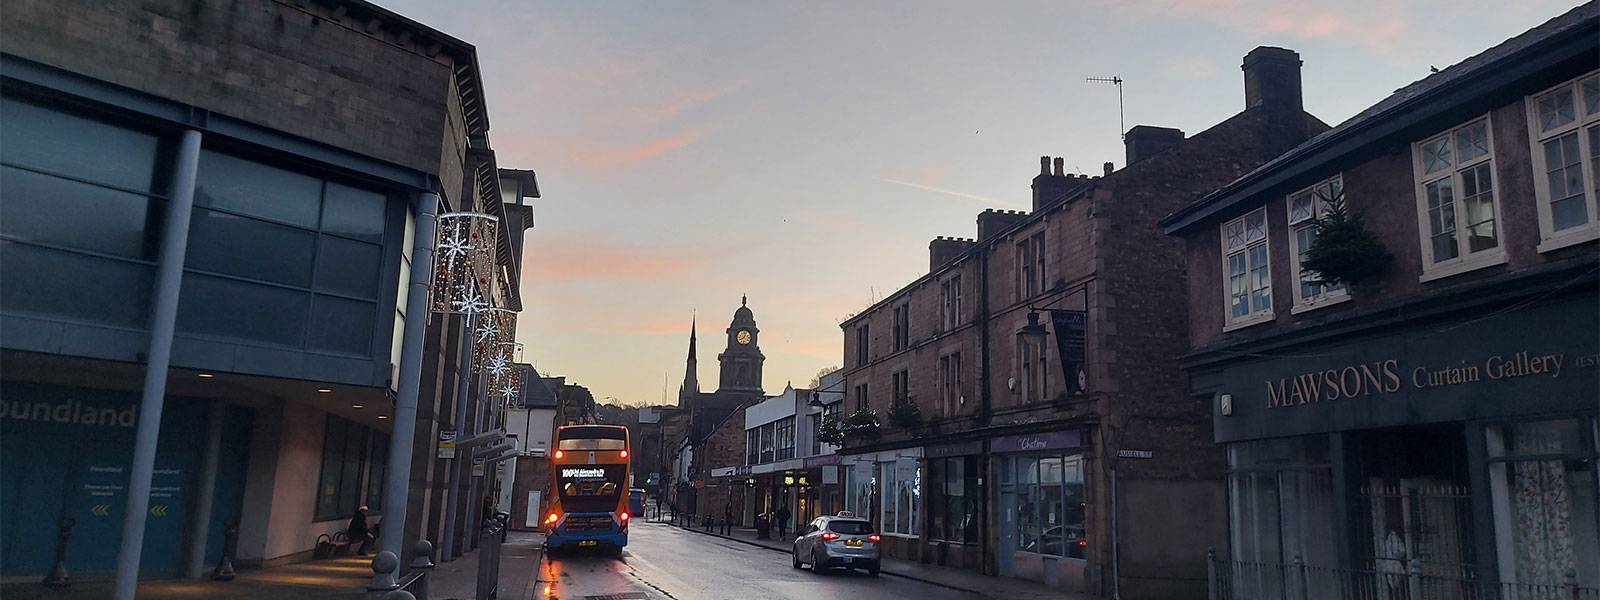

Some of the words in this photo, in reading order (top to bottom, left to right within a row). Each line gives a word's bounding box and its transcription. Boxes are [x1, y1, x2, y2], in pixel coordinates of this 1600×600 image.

[1265, 359, 1401, 409] MAWSONS
[1412, 361, 1480, 388] Curtain
[1486, 351, 1564, 379] Gallery
